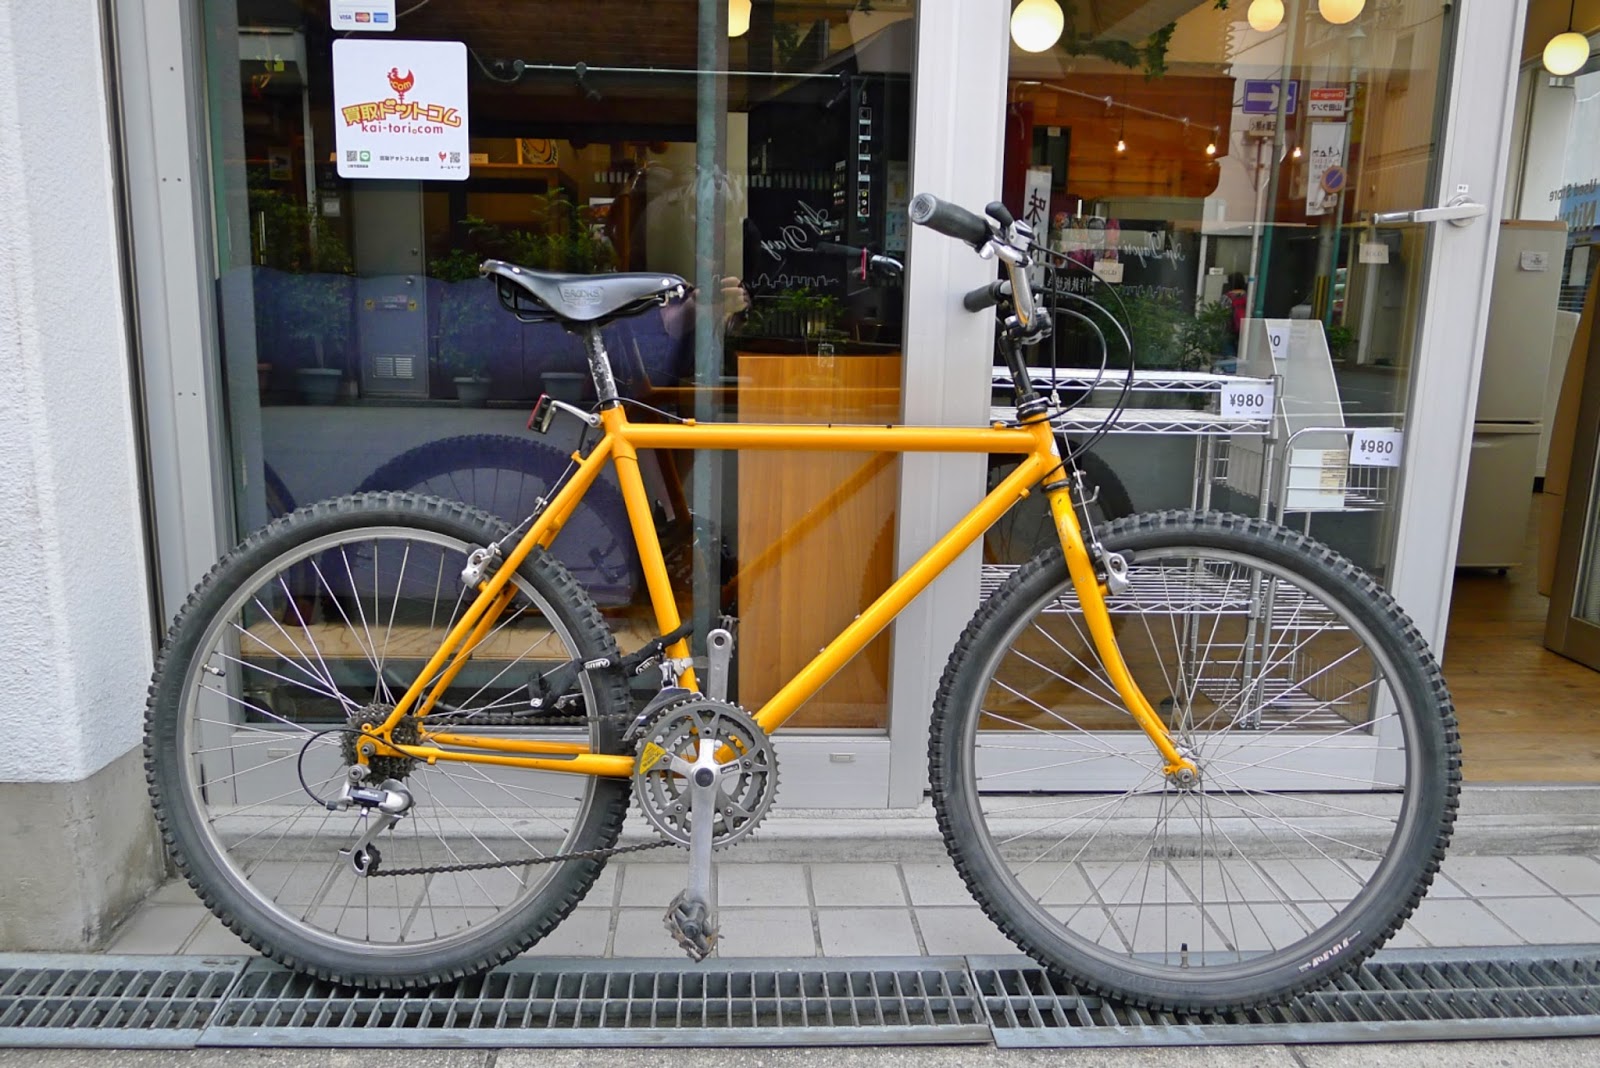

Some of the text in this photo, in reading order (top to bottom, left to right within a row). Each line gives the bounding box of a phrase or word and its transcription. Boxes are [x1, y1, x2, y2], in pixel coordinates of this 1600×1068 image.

[341, 98, 461, 128] 買取ドットコム
[361, 122, 443, 135] kai-tori.com
[564, 288, 600, 298] BROOKS
[1229, 393, 1264, 407] ¥980
[1360, 439, 1394, 454] ¥980
